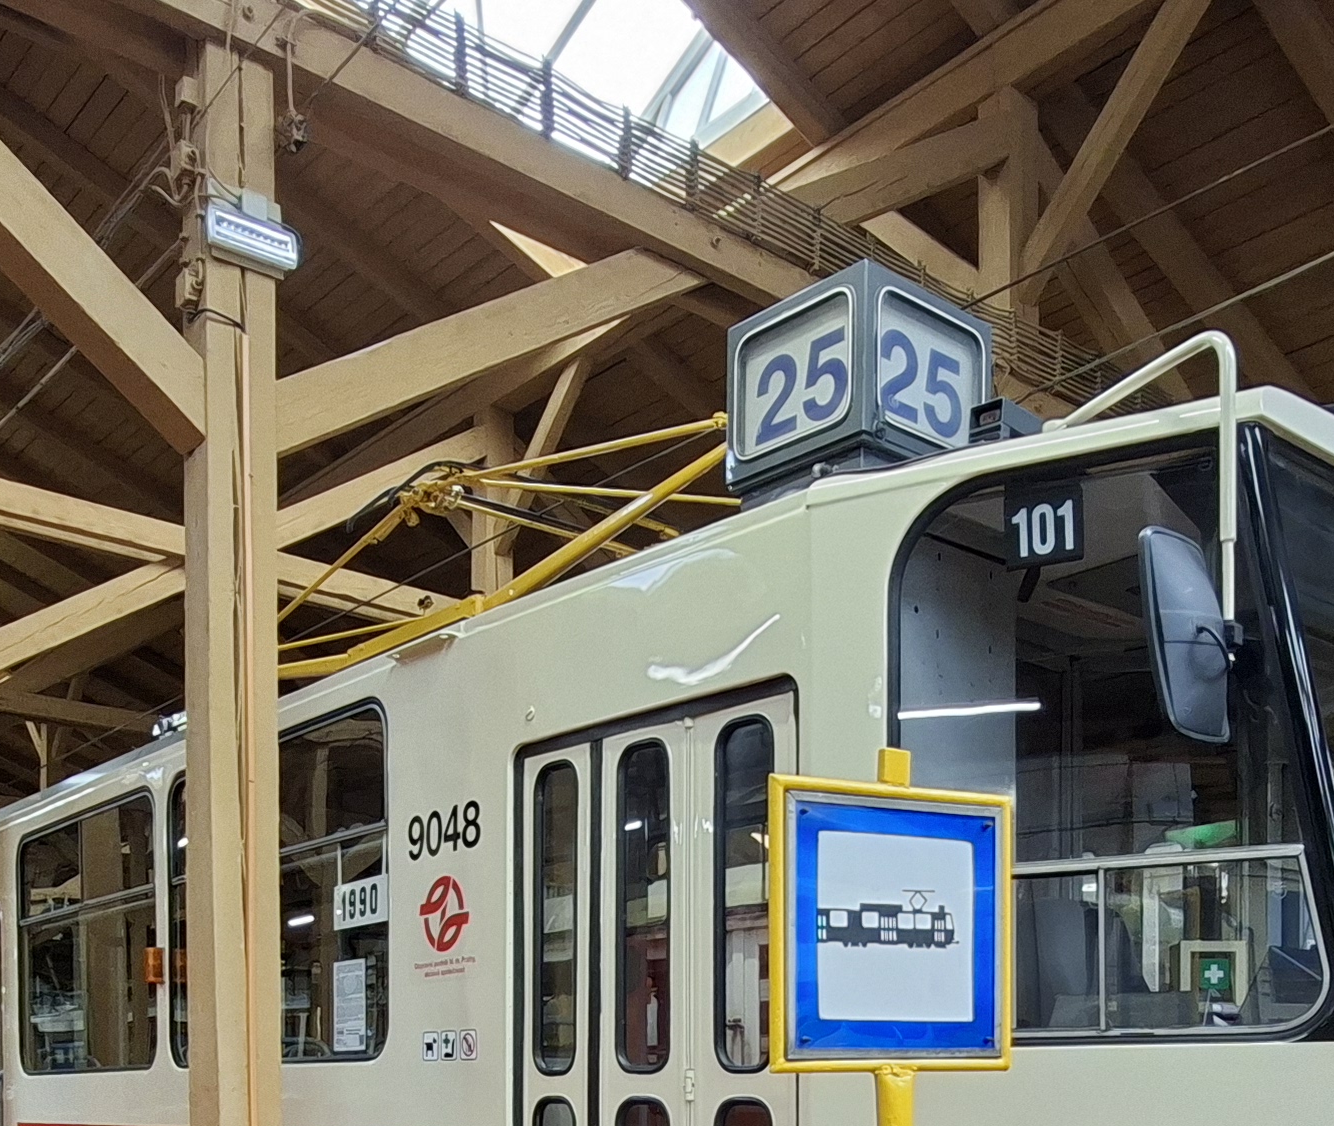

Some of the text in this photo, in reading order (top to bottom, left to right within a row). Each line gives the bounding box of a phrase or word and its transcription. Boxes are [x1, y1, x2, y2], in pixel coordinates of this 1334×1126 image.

[755, 325, 848, 446] 25
[880, 329, 962, 438] 25
[1011, 499, 1074, 558] 101
[408, 800, 481, 861] 9048
[341, 883, 378, 921] 1990
